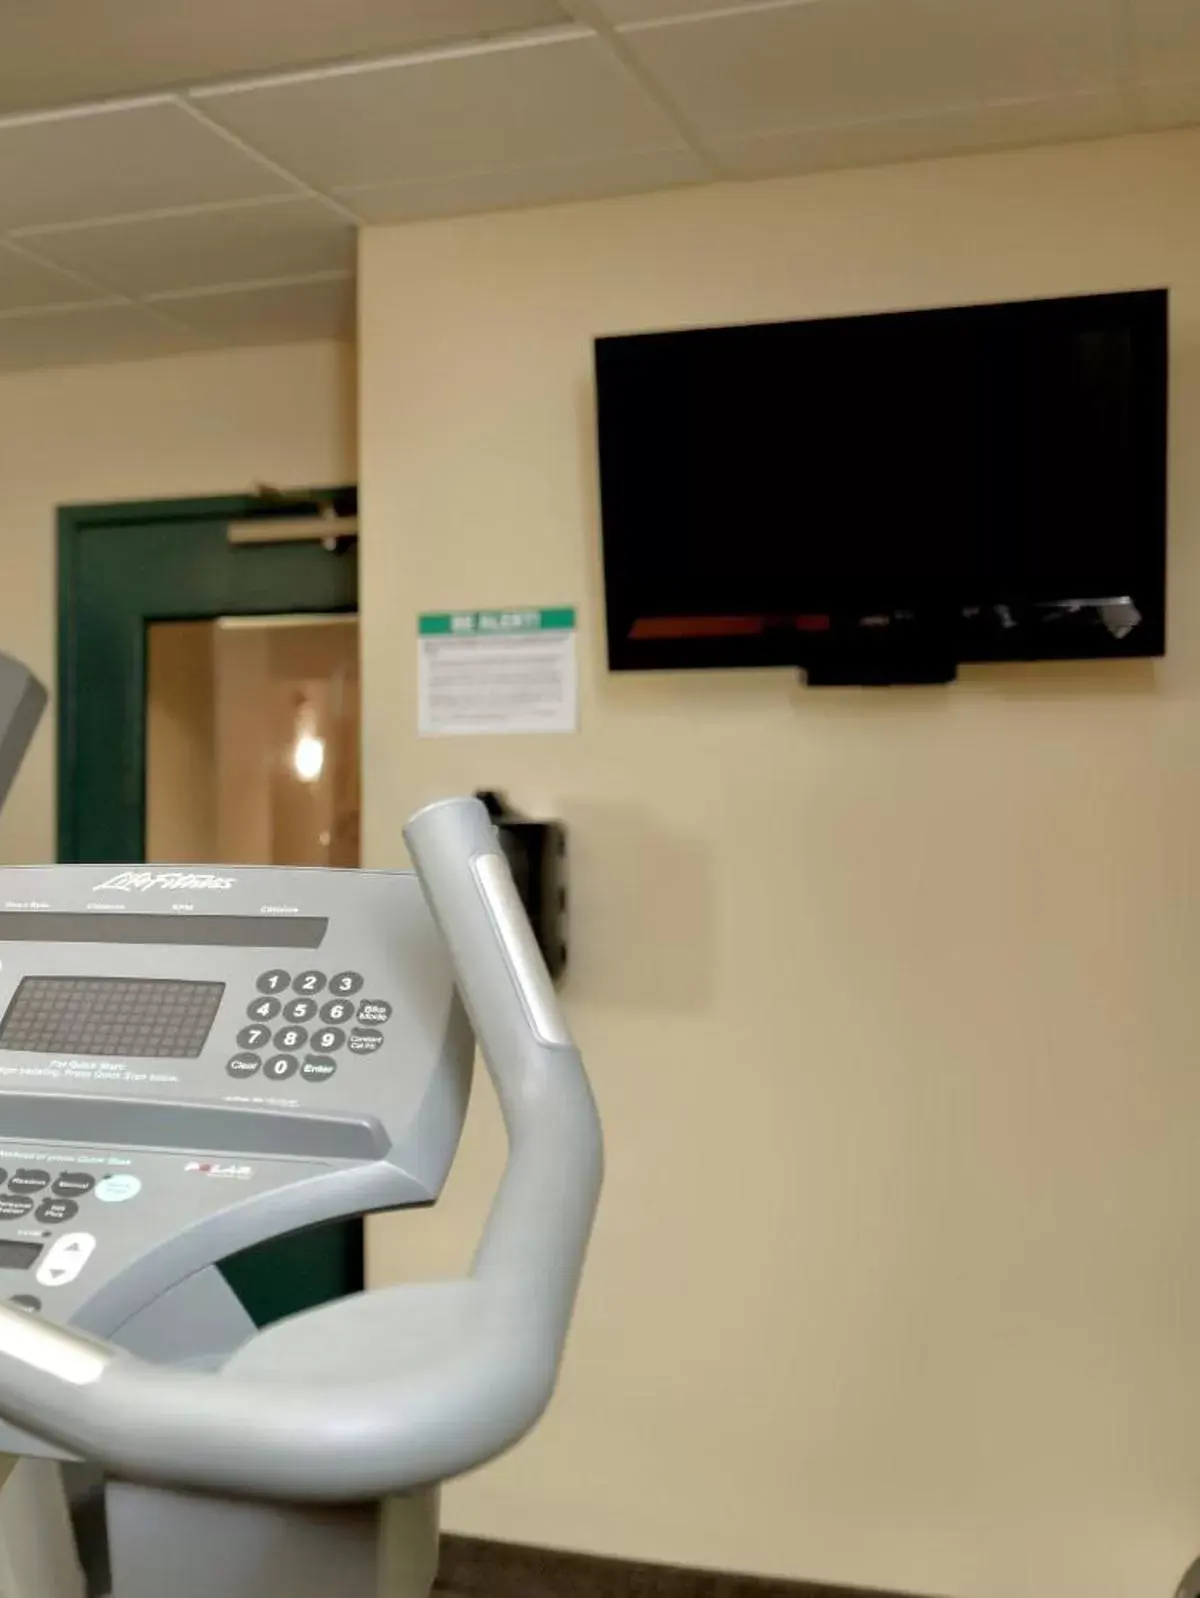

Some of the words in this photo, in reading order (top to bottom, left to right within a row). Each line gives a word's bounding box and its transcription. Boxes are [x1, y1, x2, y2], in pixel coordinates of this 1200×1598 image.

[268, 975, 279, 988] 1
[302, 976, 317, 989] 2
[338, 977, 352, 991] 3
[256, 1002, 270, 1016] 4
[293, 1004, 307, 1017] 5
[330, 1005, 344, 1018] 6
[248, 1030, 261, 1044] 7
[283, 1032, 298, 1046] 8
[321, 1033, 335, 1047] 9
[231, 1060, 258, 1070] Clear
[274, 1060, 288, 1074] 0
[303, 1064, 334, 1073] Enter
